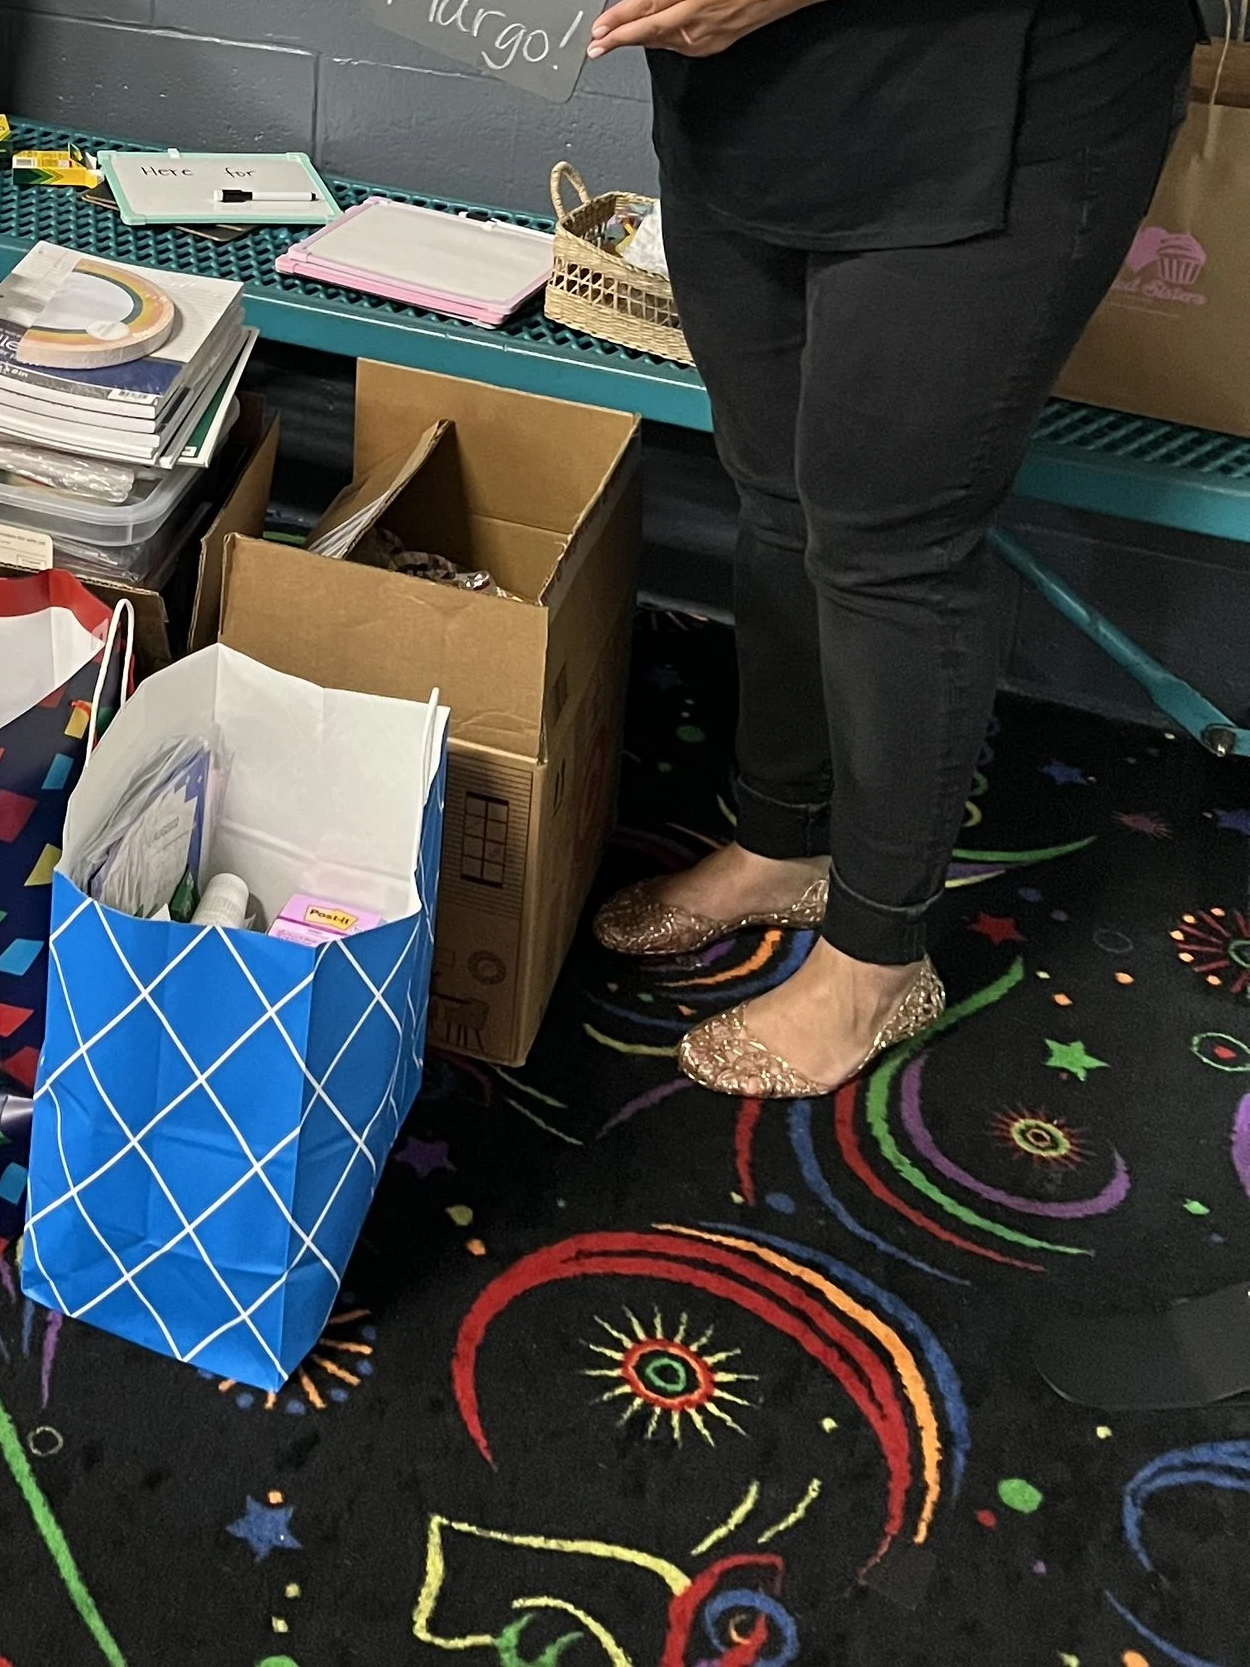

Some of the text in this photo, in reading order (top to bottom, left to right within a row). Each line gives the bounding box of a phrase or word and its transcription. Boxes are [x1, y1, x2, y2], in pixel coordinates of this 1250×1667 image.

[141, 166, 256, 179] Here for
[310, 909, 350, 925] Post-it
